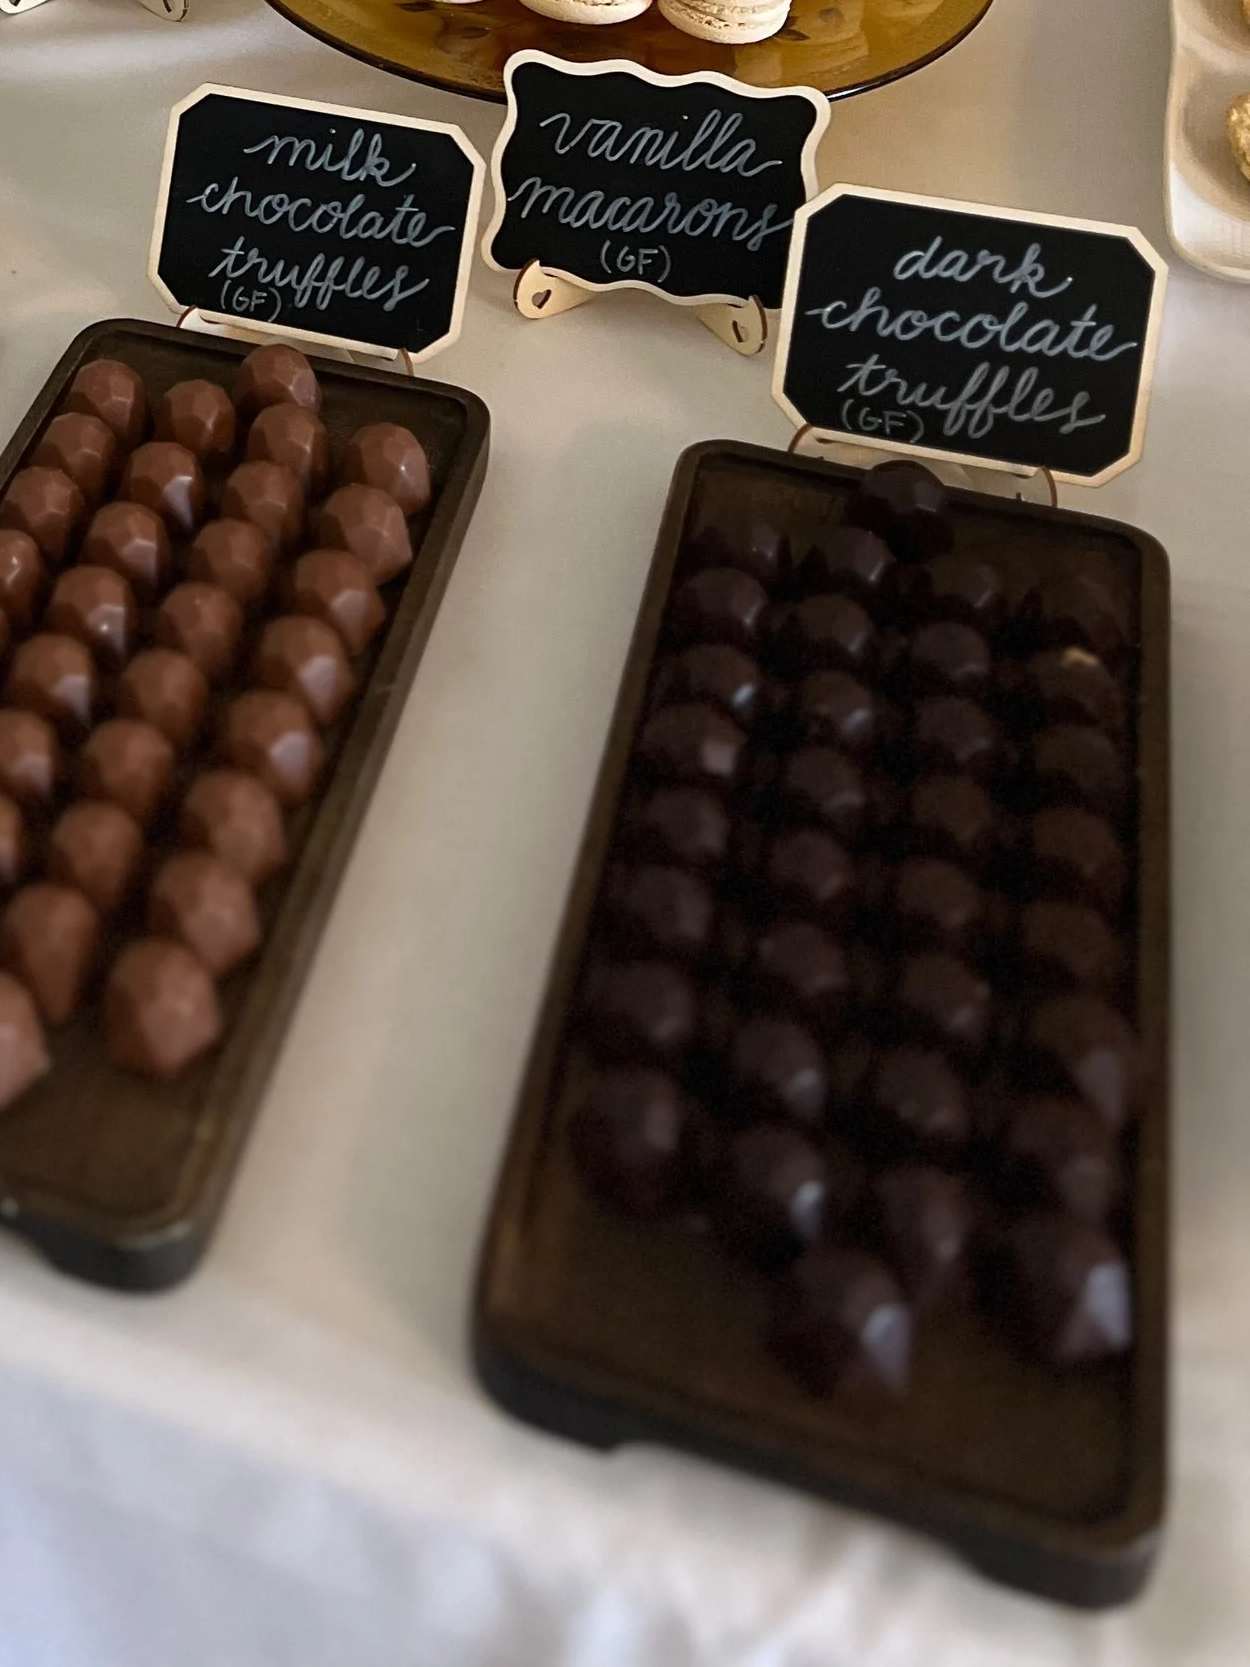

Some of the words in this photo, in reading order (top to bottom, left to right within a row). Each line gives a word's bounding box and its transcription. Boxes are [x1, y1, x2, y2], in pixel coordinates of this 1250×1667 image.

[243, 128, 417, 187] milk
[539, 109, 783, 177] vanilla
[186, 176, 456, 247] chocolate
[507, 177, 794, 251] macarons
[208, 236, 430, 312] truffles
[600, 240, 671, 283] (GF)
[894, 236, 1073, 298] dark
[220, 280, 282, 322] (GF)
[804, 287, 1138, 361] chocolate
[836, 353, 1106, 439] truffles
[841, 399, 924, 443] (GF)
